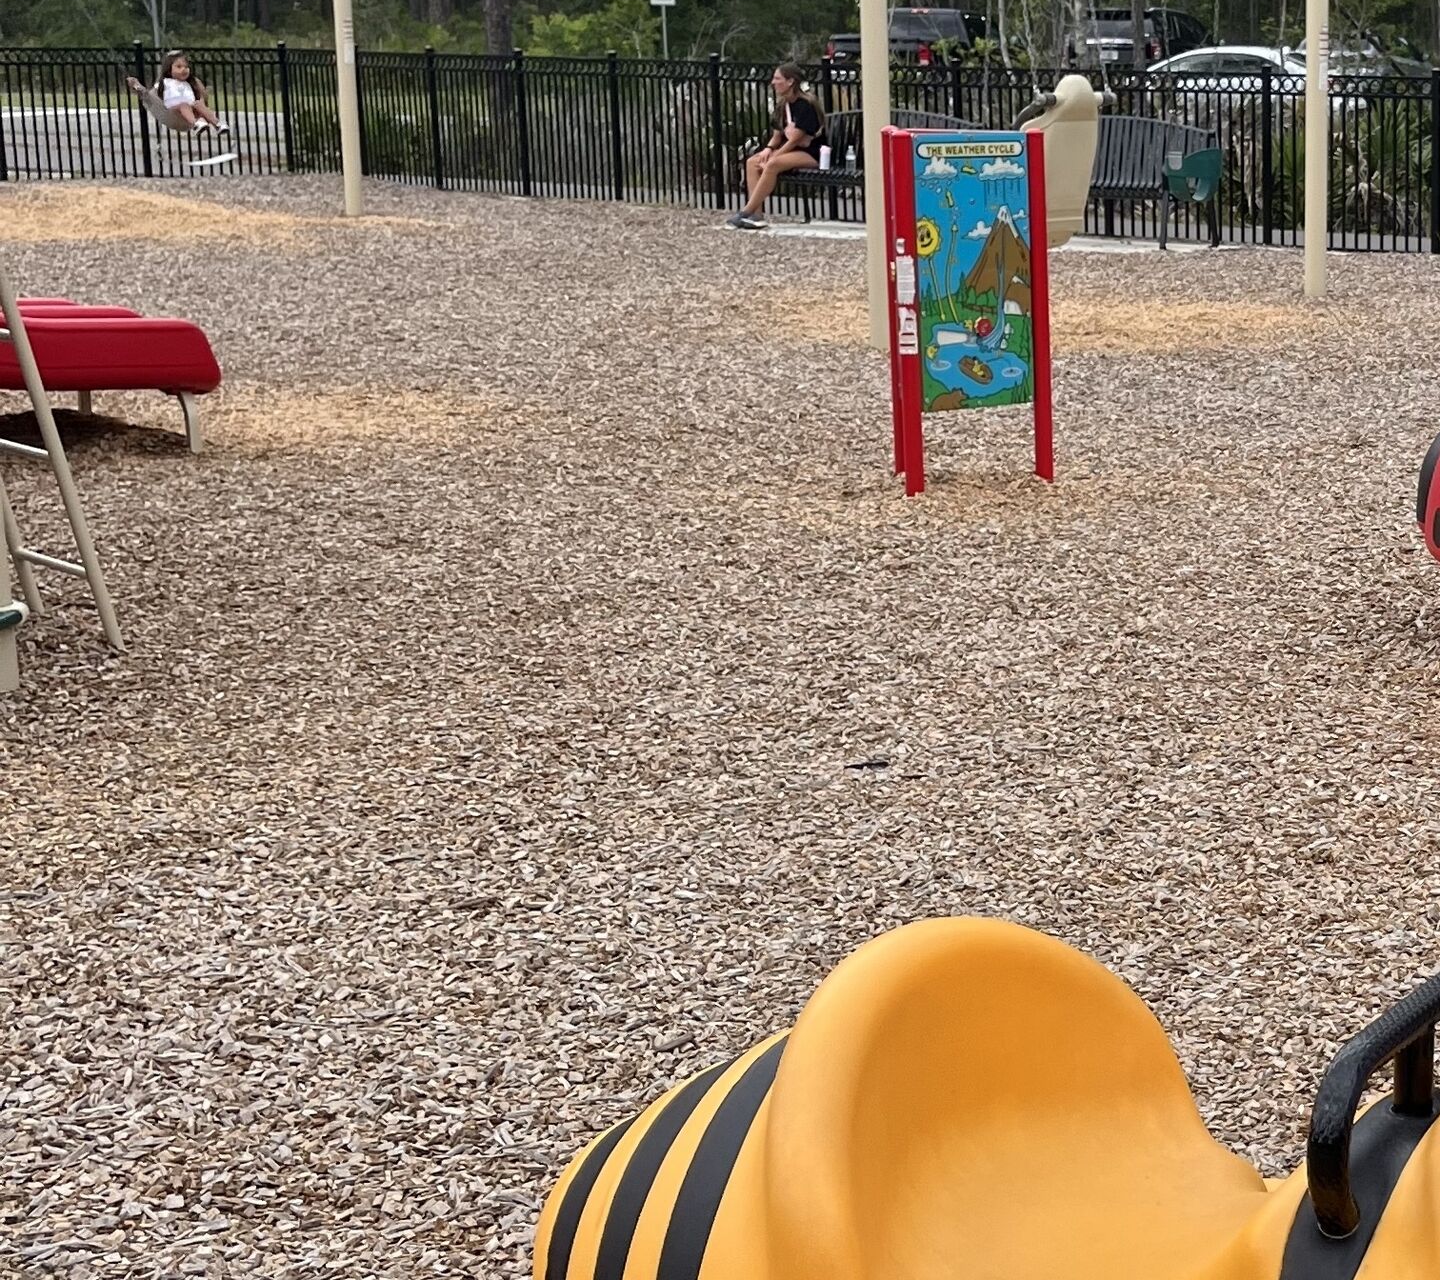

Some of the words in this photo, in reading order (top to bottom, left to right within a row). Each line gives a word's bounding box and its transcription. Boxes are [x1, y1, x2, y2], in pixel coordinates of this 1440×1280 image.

[926, 146, 942, 155] THE
[945, 145, 986, 154] WEATHER
[988, 144, 1015, 153] CYCLE
